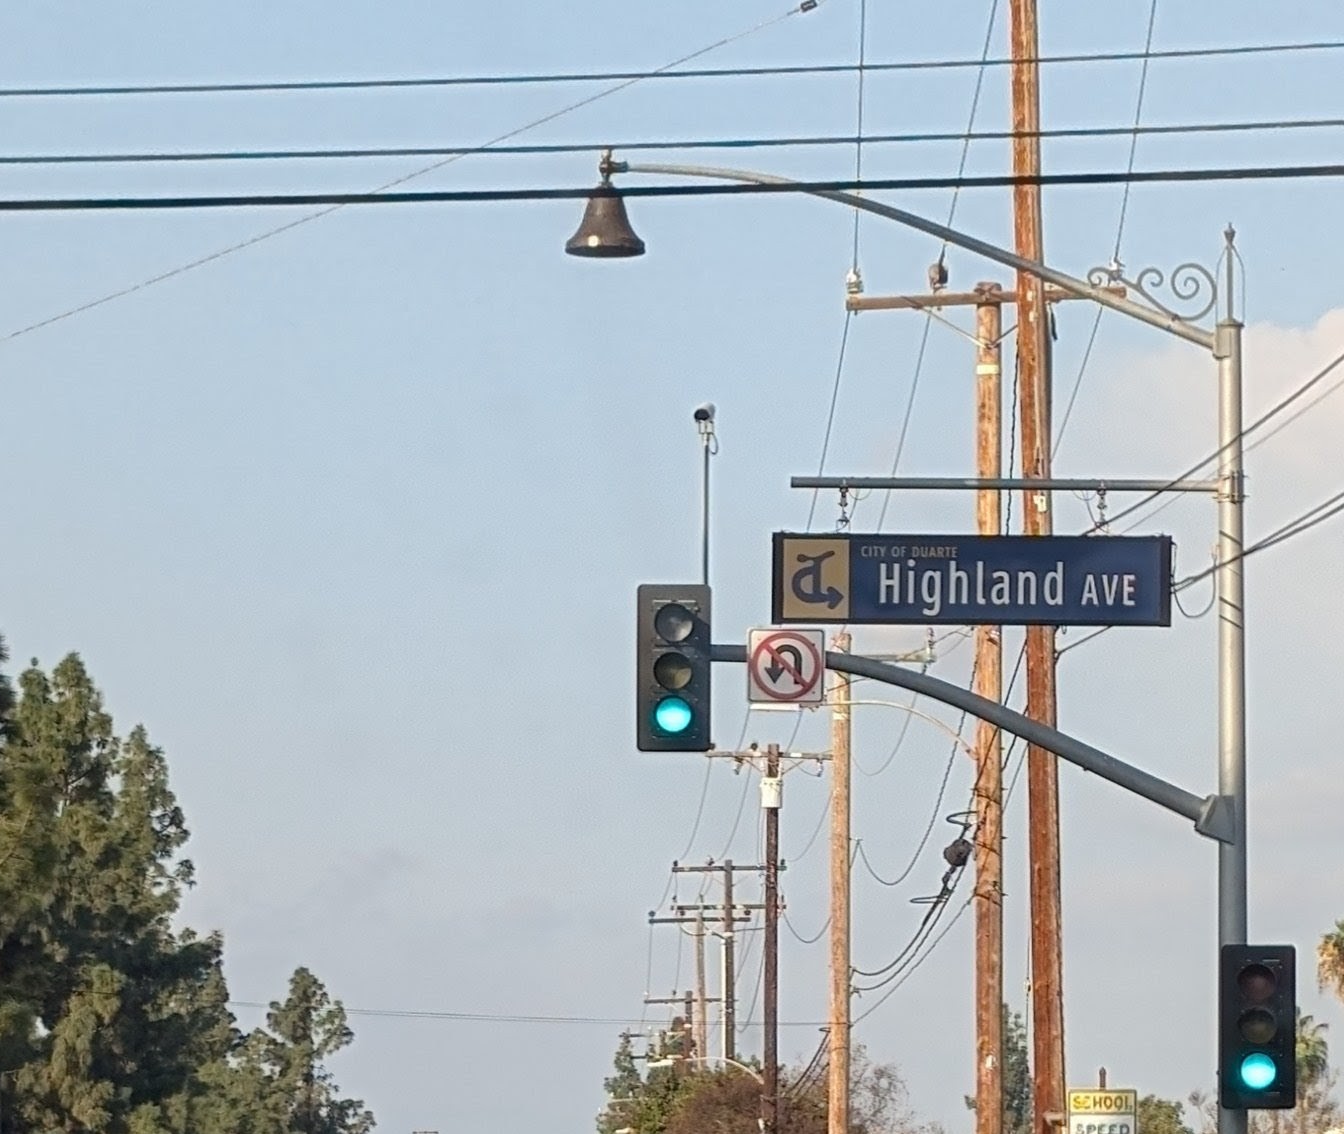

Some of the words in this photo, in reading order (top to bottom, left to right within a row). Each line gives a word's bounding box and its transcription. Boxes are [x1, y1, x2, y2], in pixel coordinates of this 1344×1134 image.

[860, 545, 887, 558] CITY
[891, 545, 907, 558] OF
[911, 545, 958, 558] DUARTE
[878, 559, 1065, 616] Highland
[1081, 573, 1136, 606] AVE
[1073, 1095, 1132, 1111] SCHOOL
